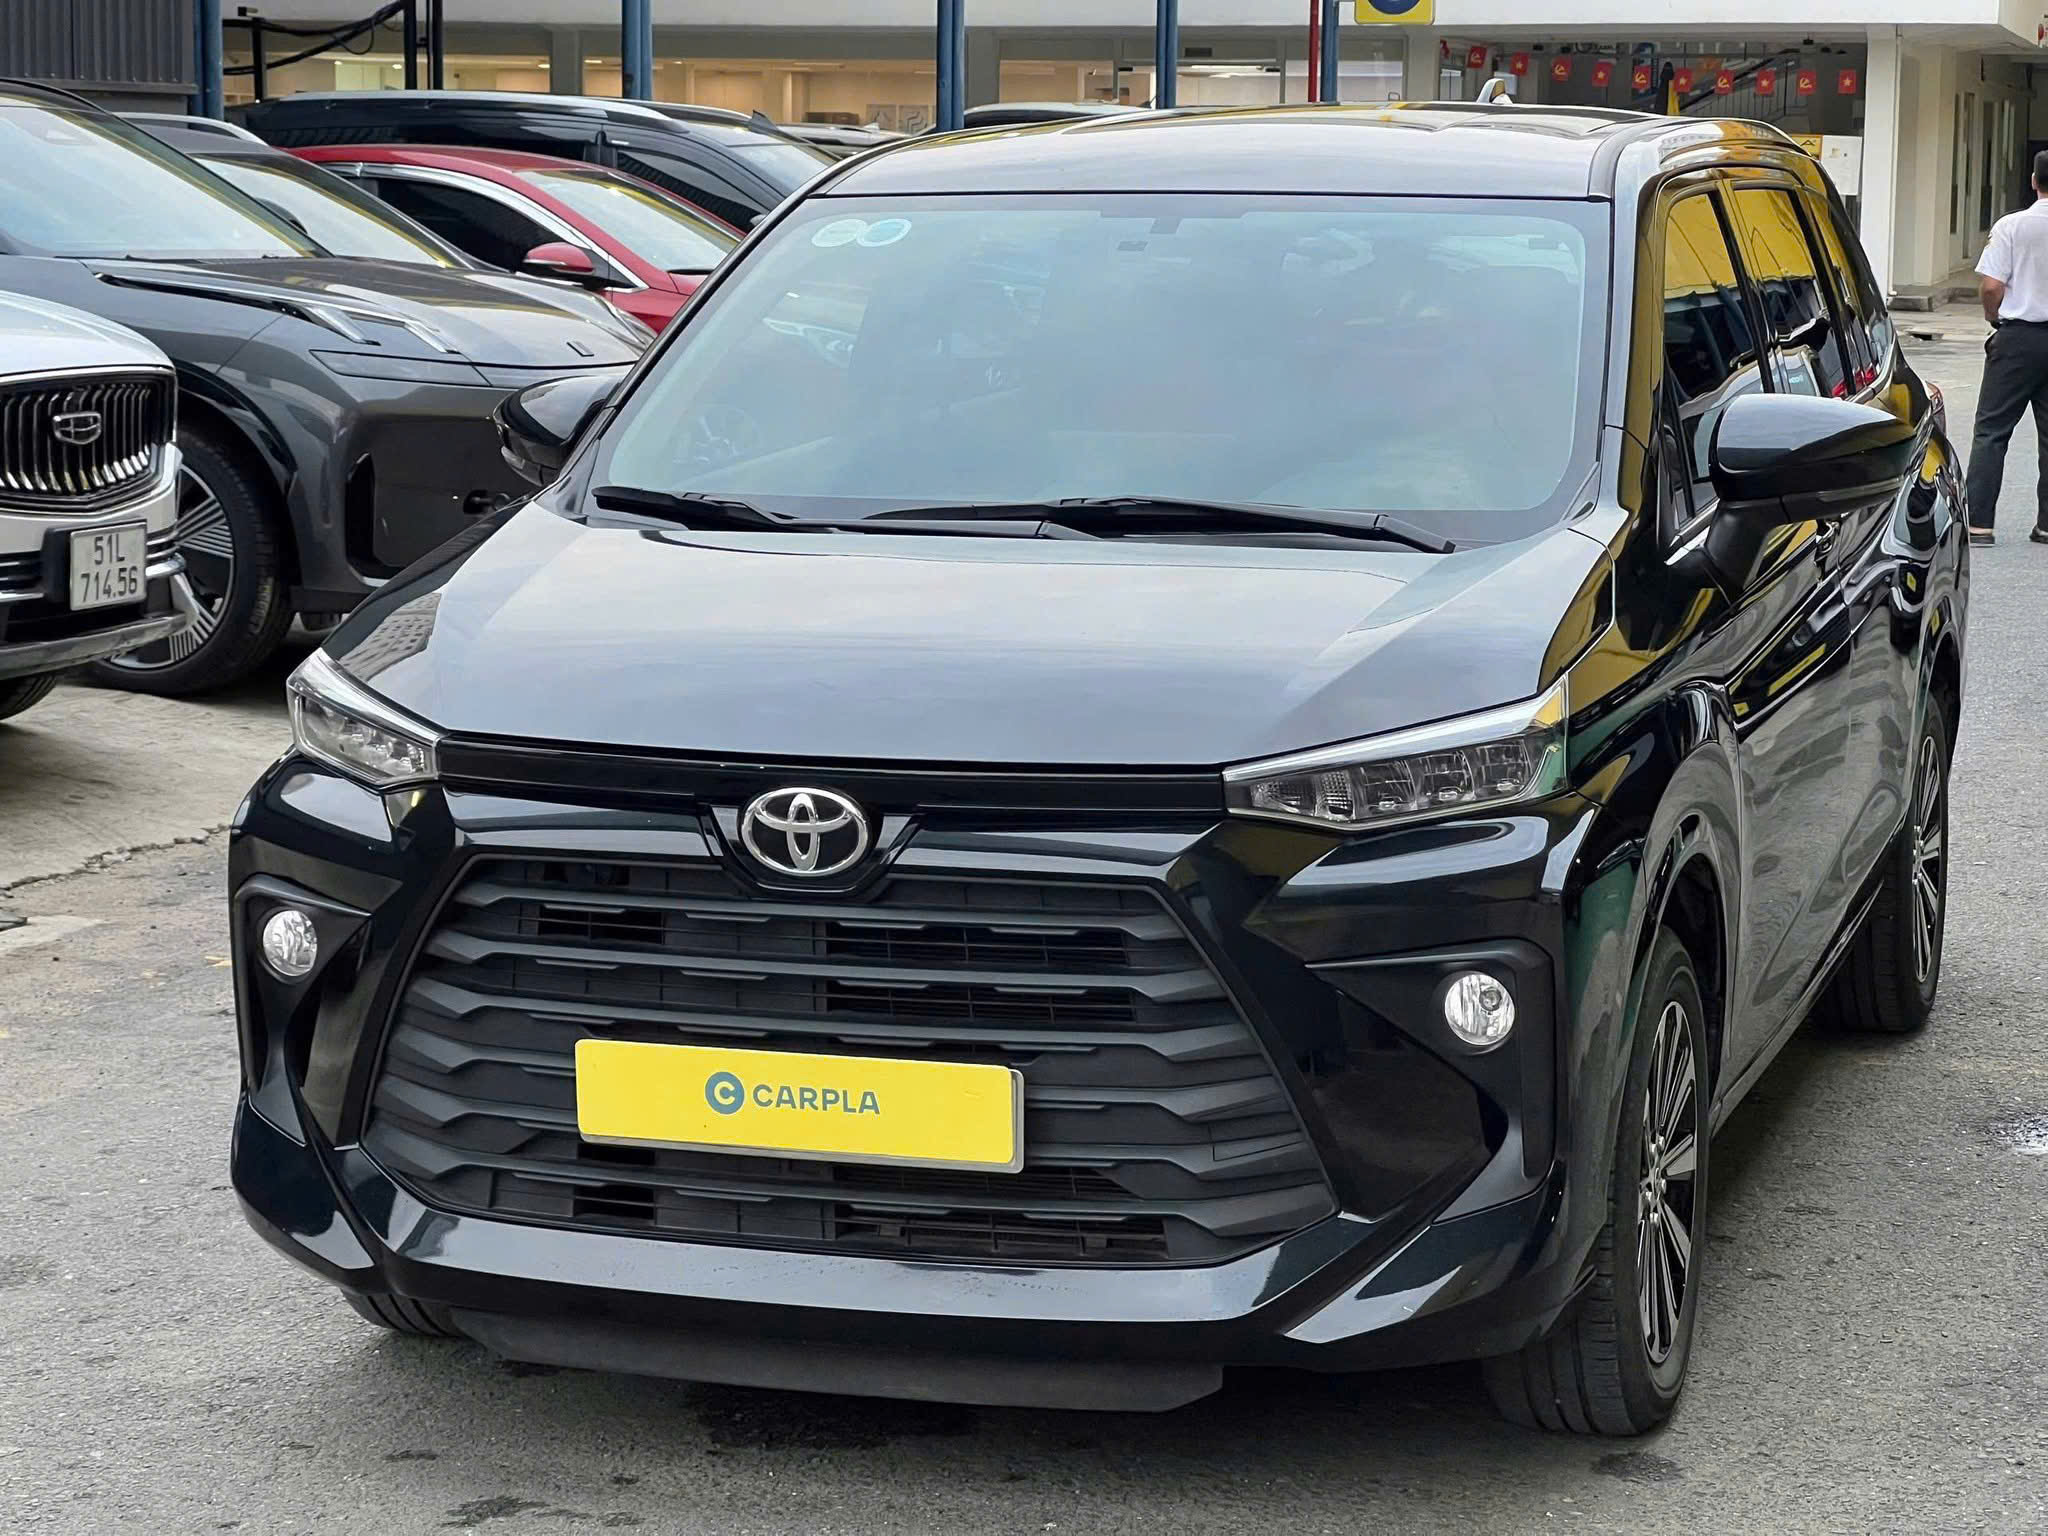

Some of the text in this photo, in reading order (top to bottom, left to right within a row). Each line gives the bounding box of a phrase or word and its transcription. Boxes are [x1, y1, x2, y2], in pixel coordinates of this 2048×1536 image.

[94, 533, 125, 565] 51L
[81, 565, 138, 602] 714.56
[752, 1083, 881, 1115] CARPLA
